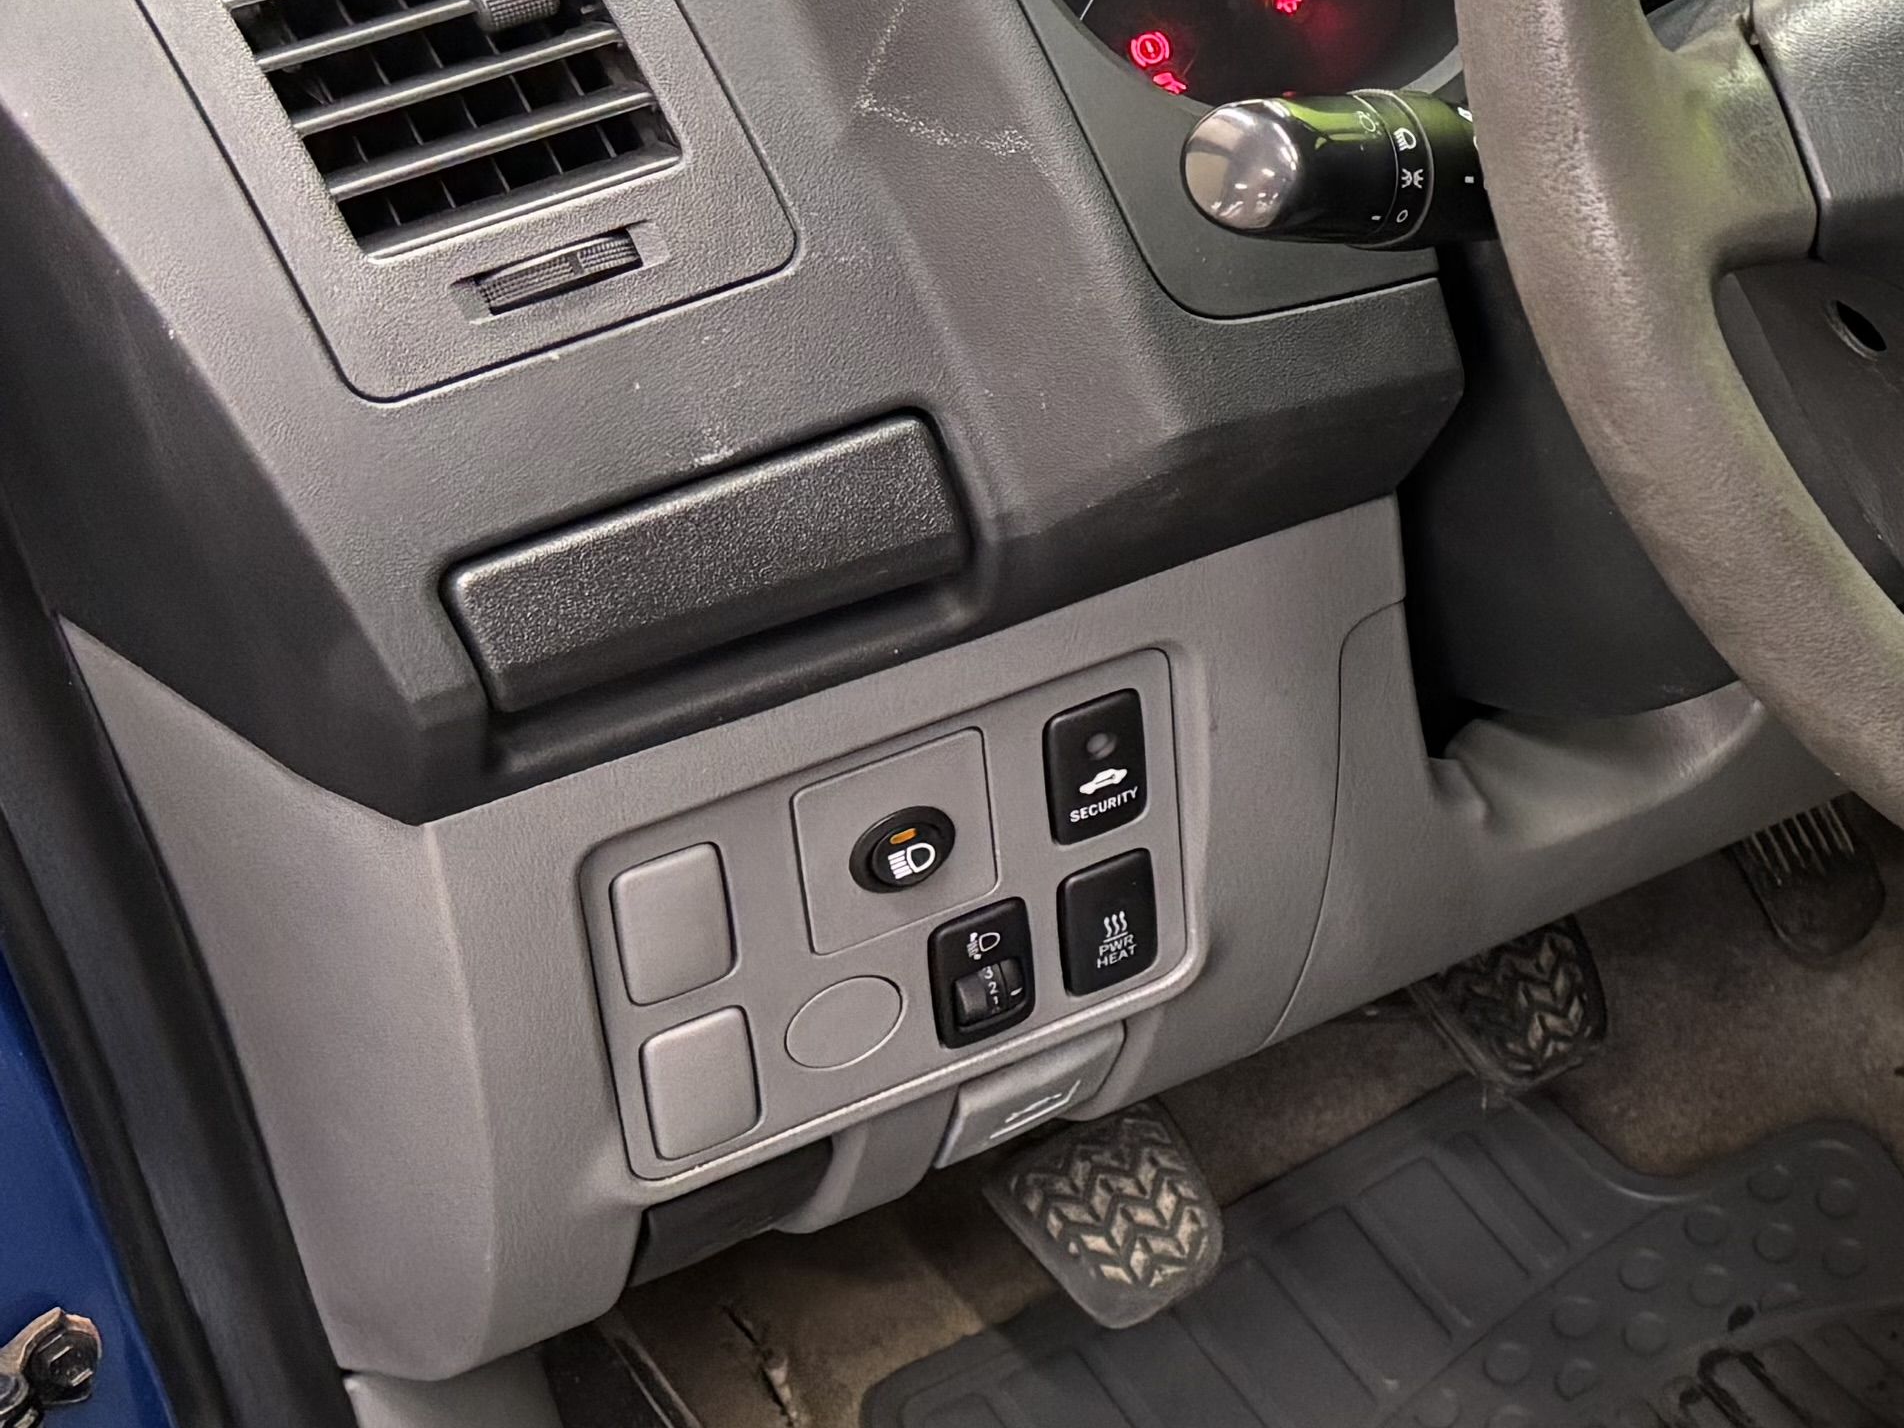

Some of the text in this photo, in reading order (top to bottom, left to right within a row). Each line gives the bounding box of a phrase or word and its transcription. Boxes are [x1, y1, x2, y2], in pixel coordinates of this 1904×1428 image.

[1069, 785, 1139, 823] SECURITY
[1096, 943, 1137, 969] HEAT
[1099, 933, 1134, 957] PWR
[984, 965, 994, 980] 3
[988, 981, 999, 995] 2
